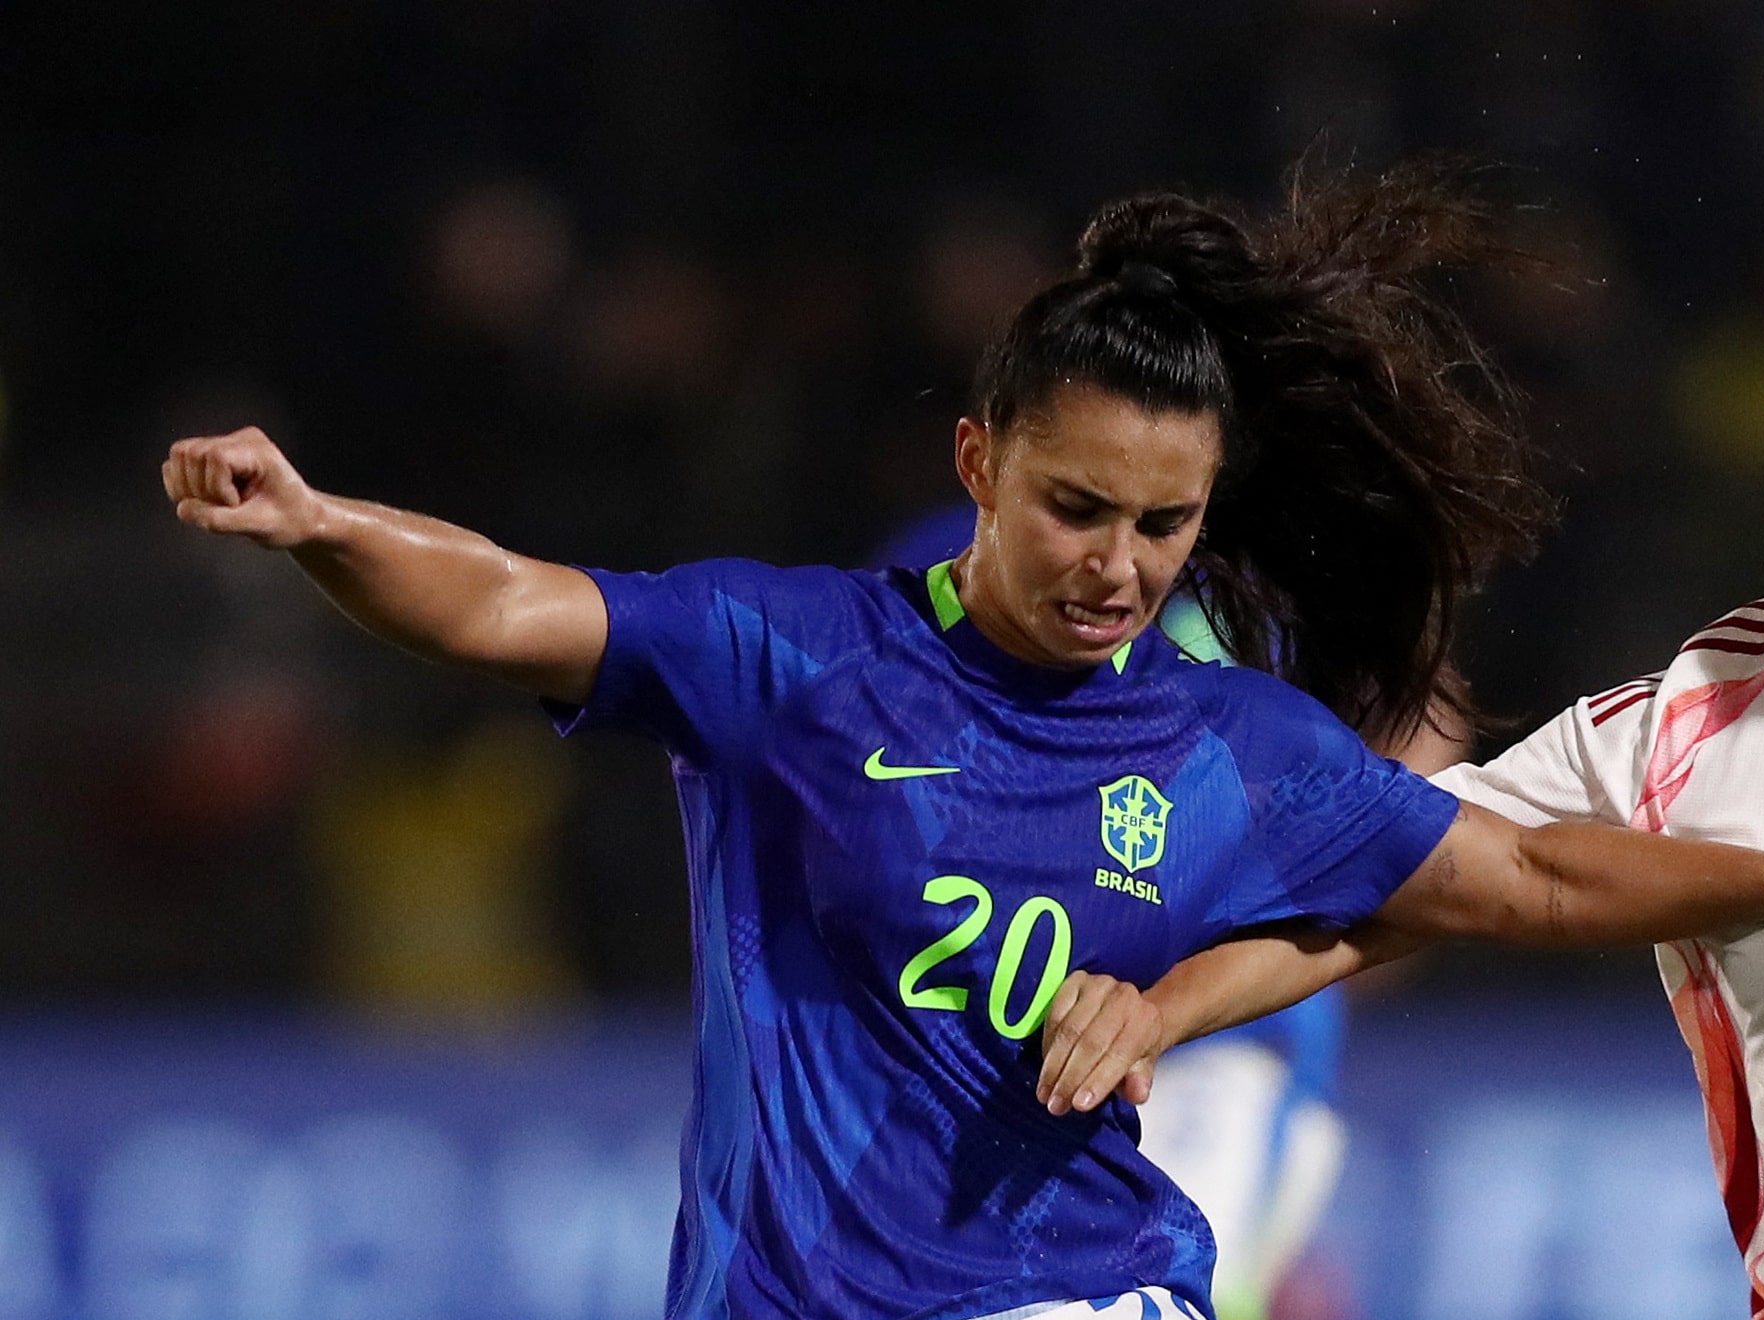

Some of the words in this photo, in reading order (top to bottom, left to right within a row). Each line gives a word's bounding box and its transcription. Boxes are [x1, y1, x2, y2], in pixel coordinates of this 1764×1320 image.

[1121, 813, 1146, 829] CBF
[1095, 868, 1163, 905] BRASIL
[899, 875, 1072, 1040] 20
